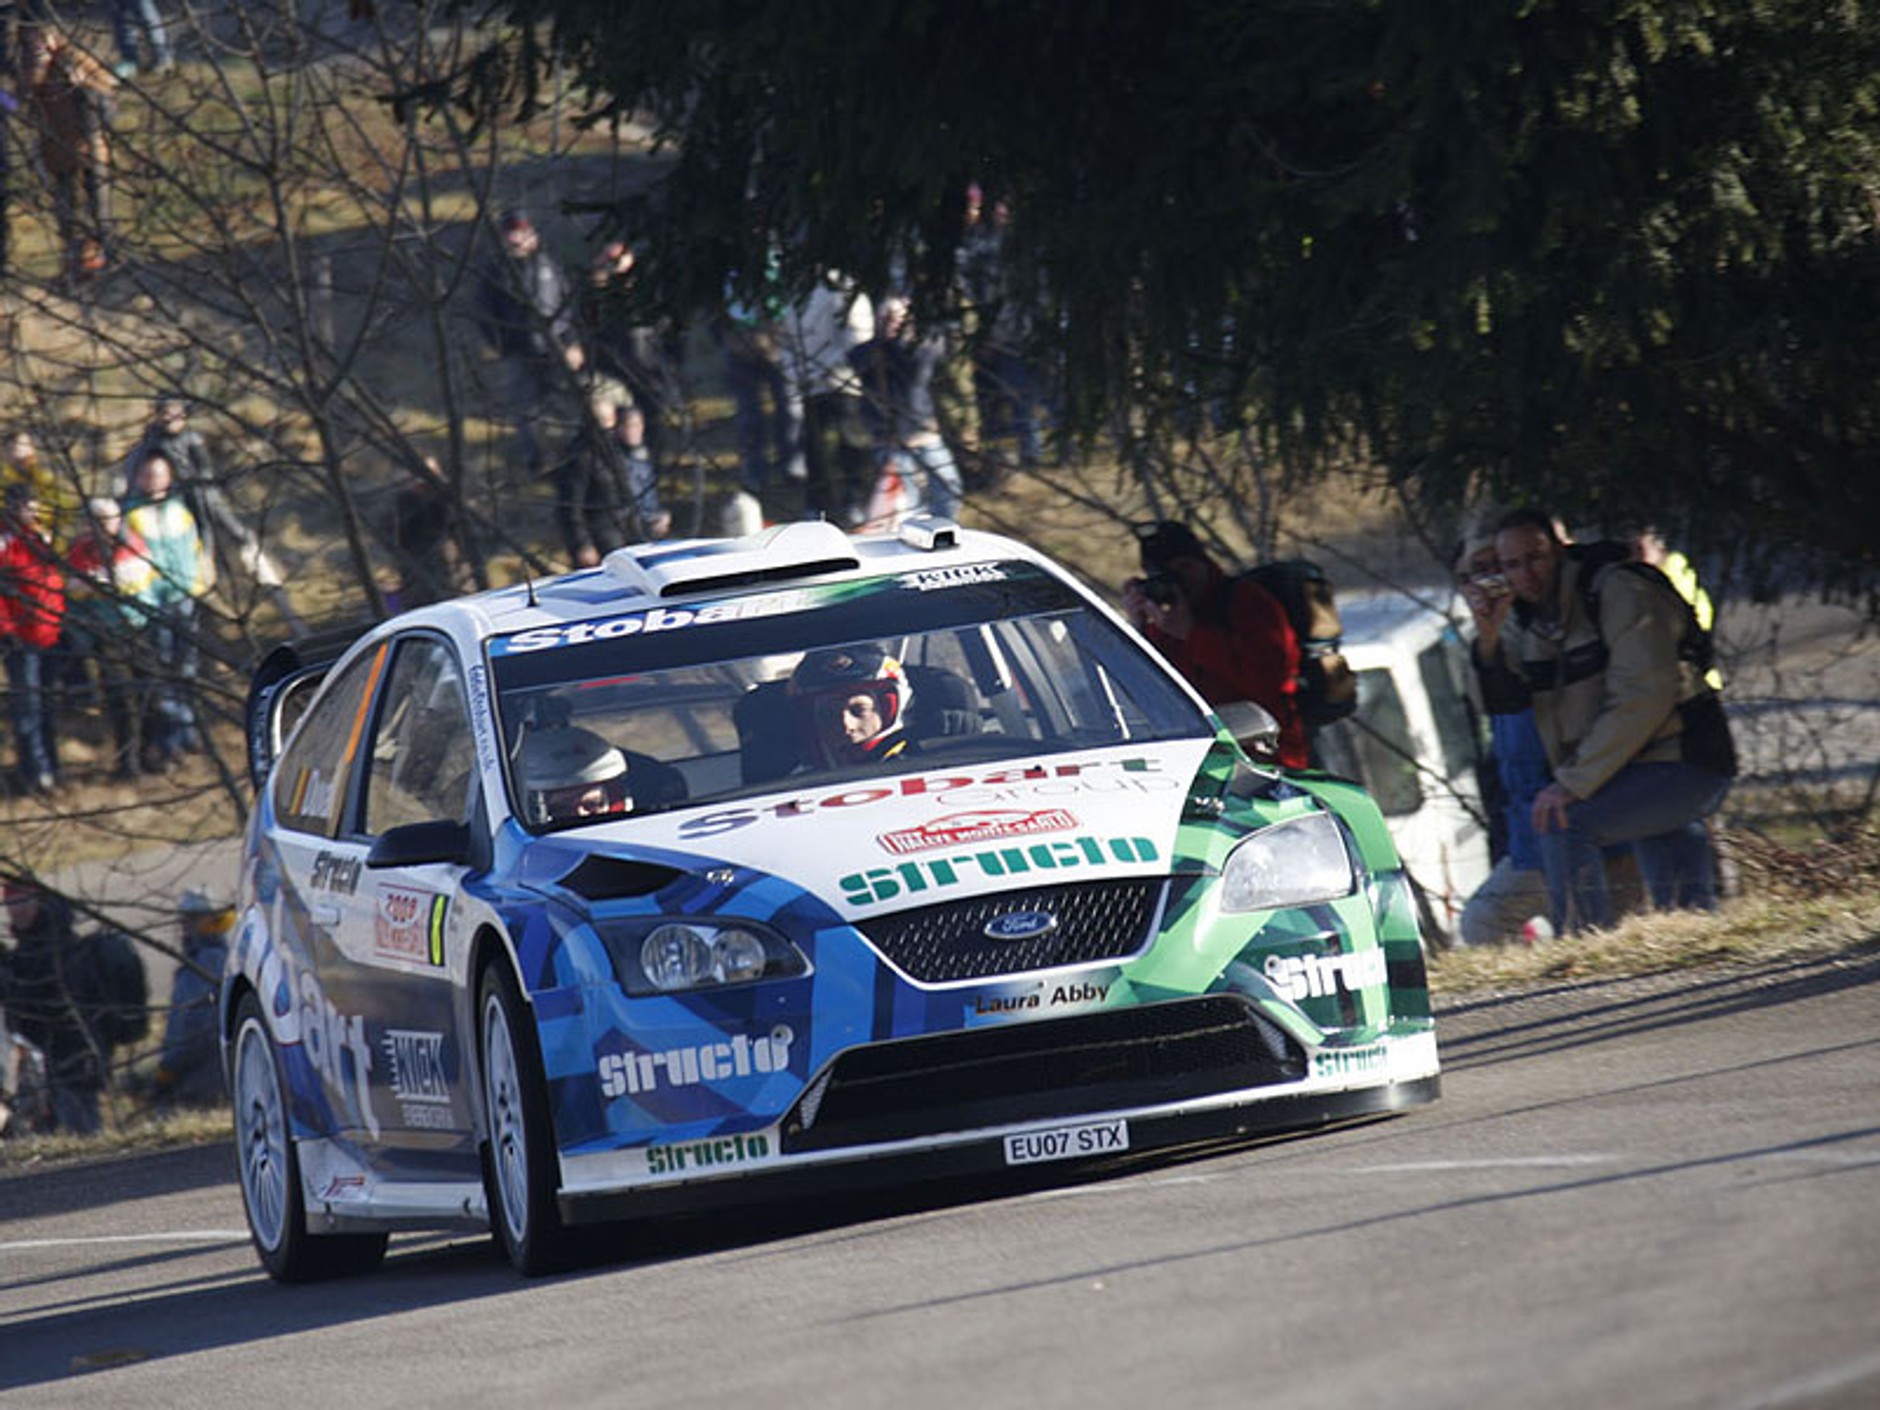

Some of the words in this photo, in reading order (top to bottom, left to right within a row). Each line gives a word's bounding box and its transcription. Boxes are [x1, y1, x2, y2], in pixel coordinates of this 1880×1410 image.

[678, 756, 1163, 840] Stobart
[1002, 912, 1038, 933] Ford
[975, 991, 1040, 1016] Laura
[1050, 983, 1110, 1006] Abby
[1011, 1132, 1069, 1160] EU07
[1078, 1126, 1122, 1150] STX
